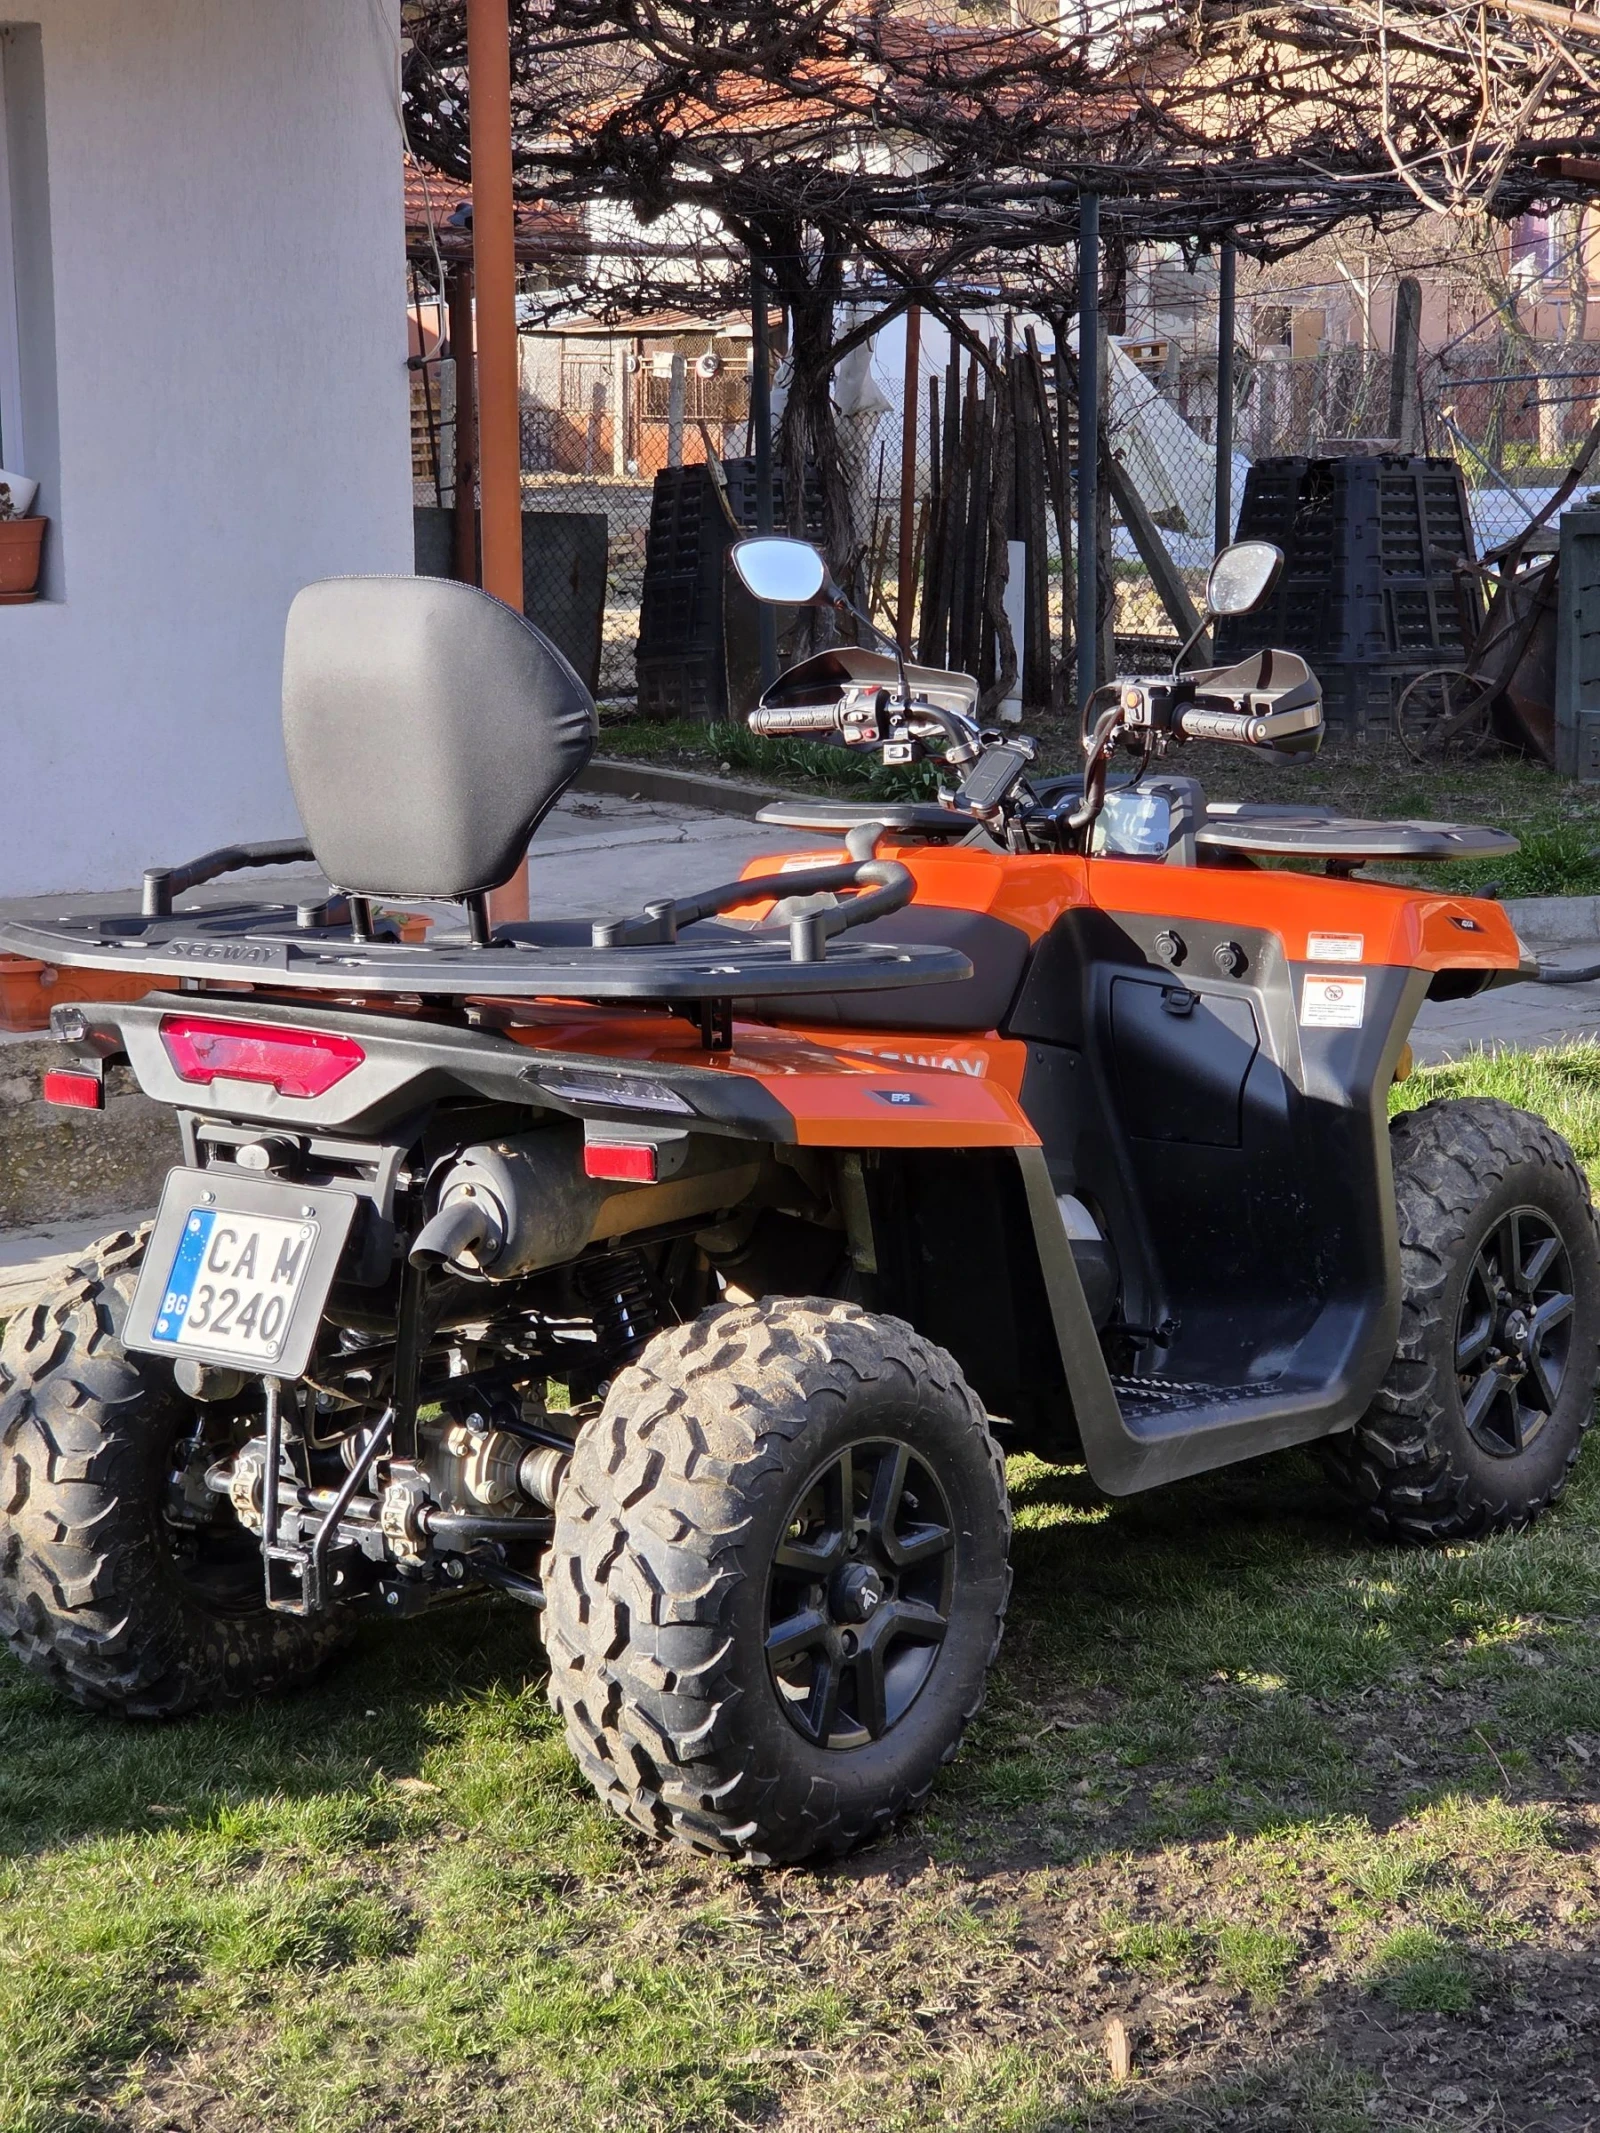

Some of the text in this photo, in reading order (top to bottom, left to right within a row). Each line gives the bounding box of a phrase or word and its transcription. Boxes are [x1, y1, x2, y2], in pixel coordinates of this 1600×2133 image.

[167, 941, 281, 962] SEGWAY
[891, 1093, 910, 1102] EPS
[208, 1229, 305, 1286] CA M
[162, 1292, 188, 1316] BG
[188, 1284, 287, 1342] 3240
